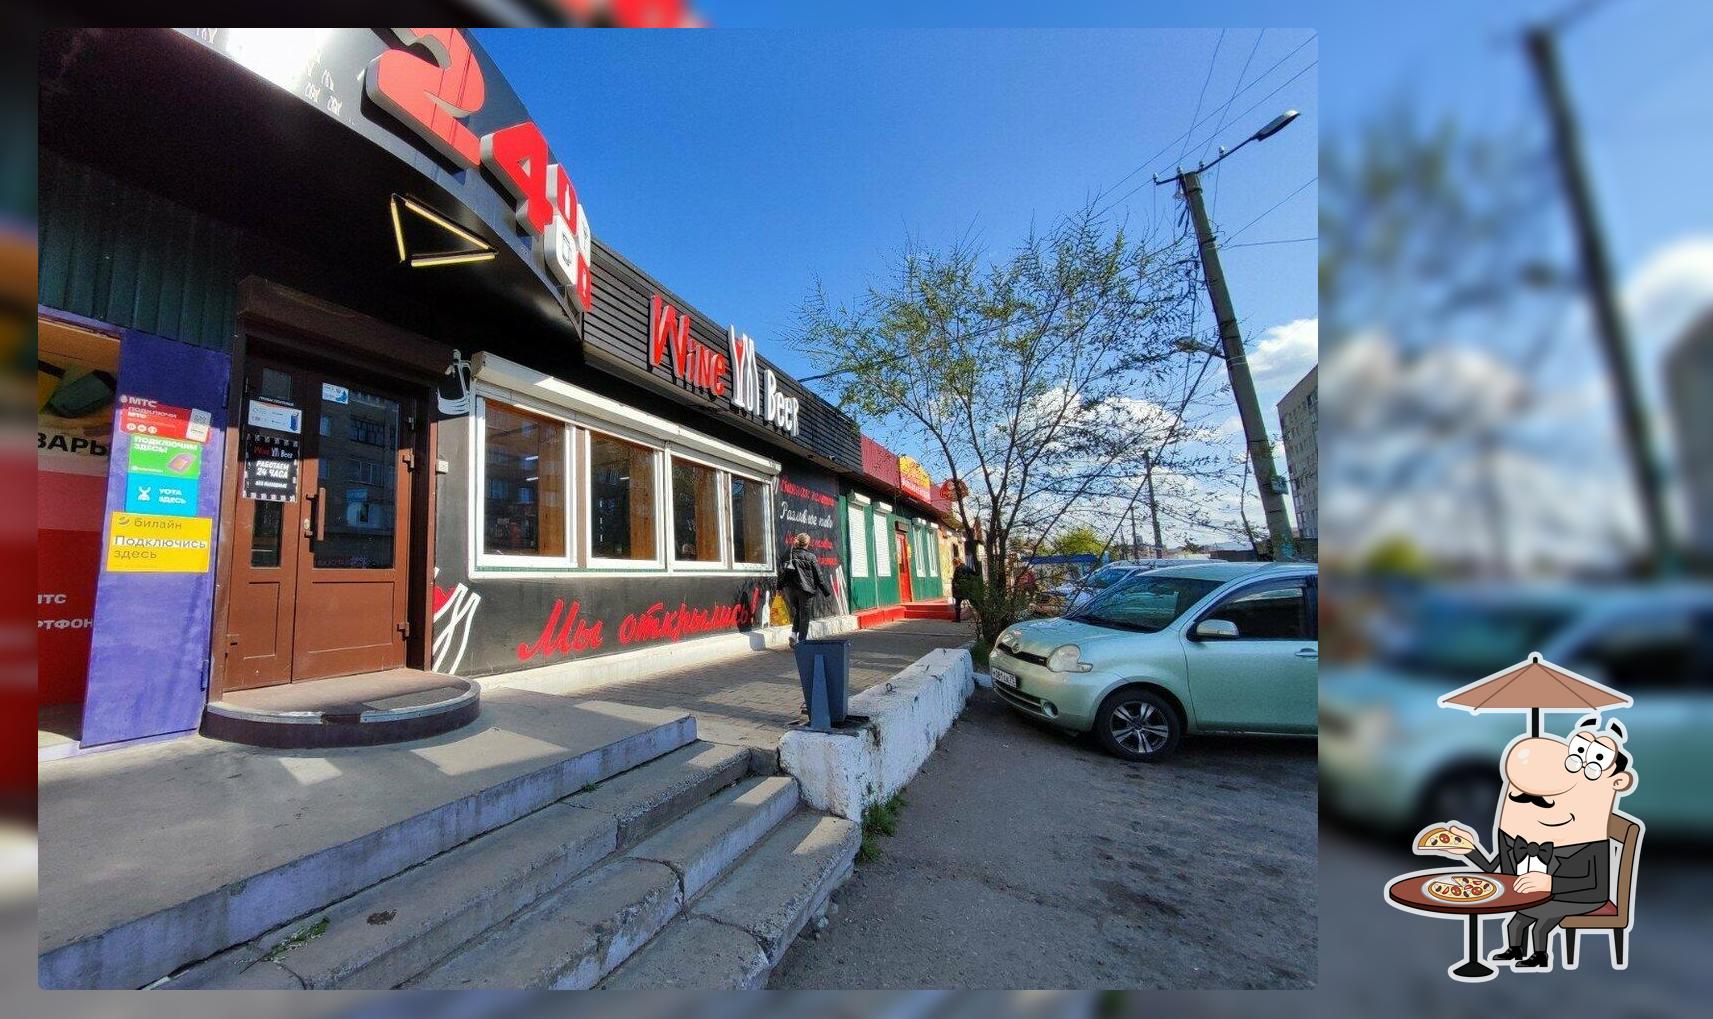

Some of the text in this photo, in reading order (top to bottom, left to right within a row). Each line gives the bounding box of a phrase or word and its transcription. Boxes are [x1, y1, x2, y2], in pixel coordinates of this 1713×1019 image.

[129, 396, 158, 408] МТС
[256, 467, 289, 479] 24 ЧАСА
[134, 517, 182, 529] билайн
[114, 535, 206, 549] Подключись
[113, 549, 157, 560] здесь
[517, 598, 604, 661] Мы
